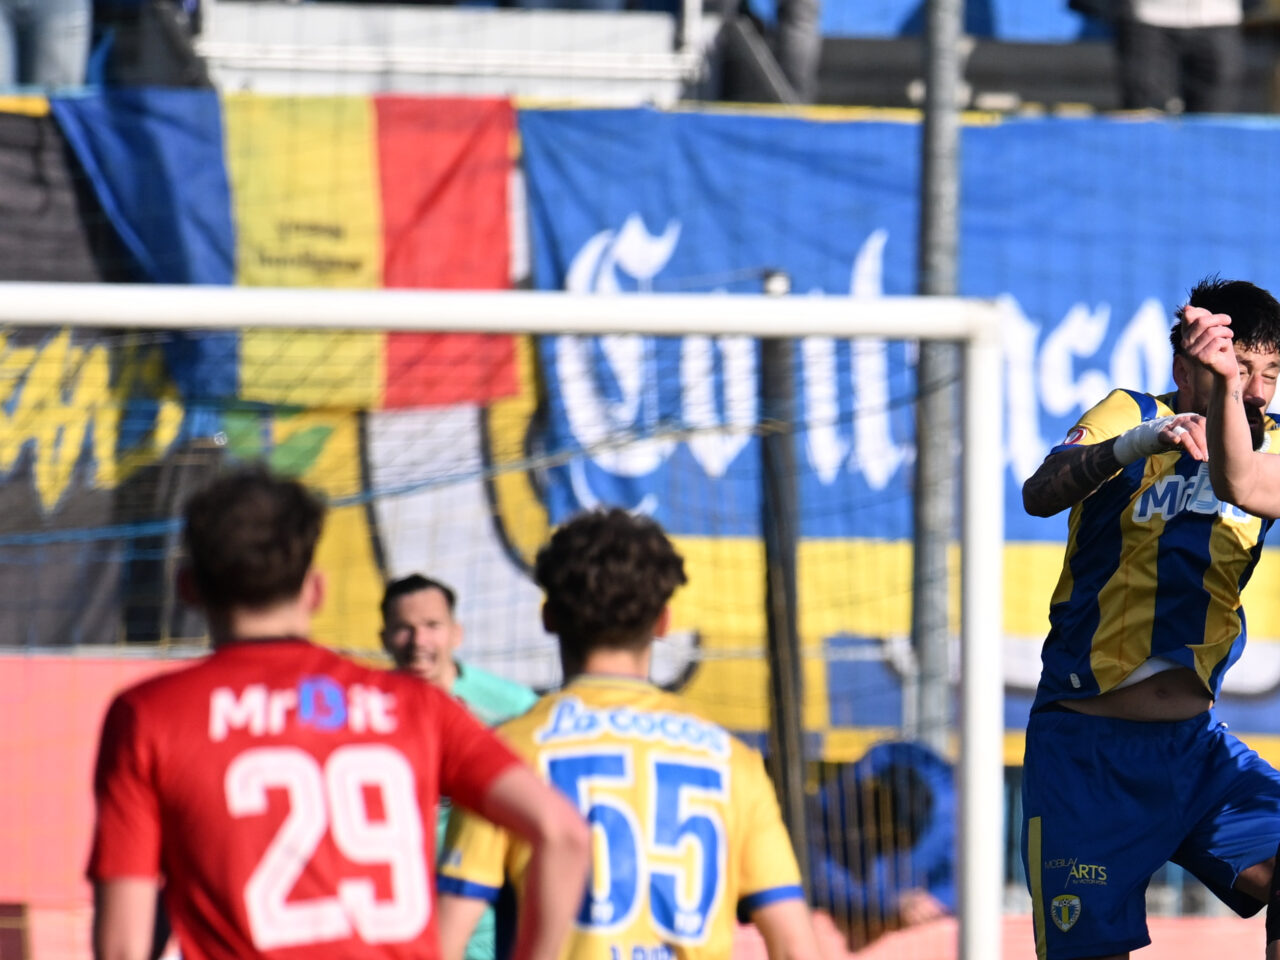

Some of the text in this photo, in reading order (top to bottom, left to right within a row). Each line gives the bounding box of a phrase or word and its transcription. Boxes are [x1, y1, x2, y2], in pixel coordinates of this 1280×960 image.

[208, 674, 399, 742] MrBit
[223, 743, 432, 950] 29
[543, 746, 729, 943] 55
[1070, 863, 1108, 881] ARTS
